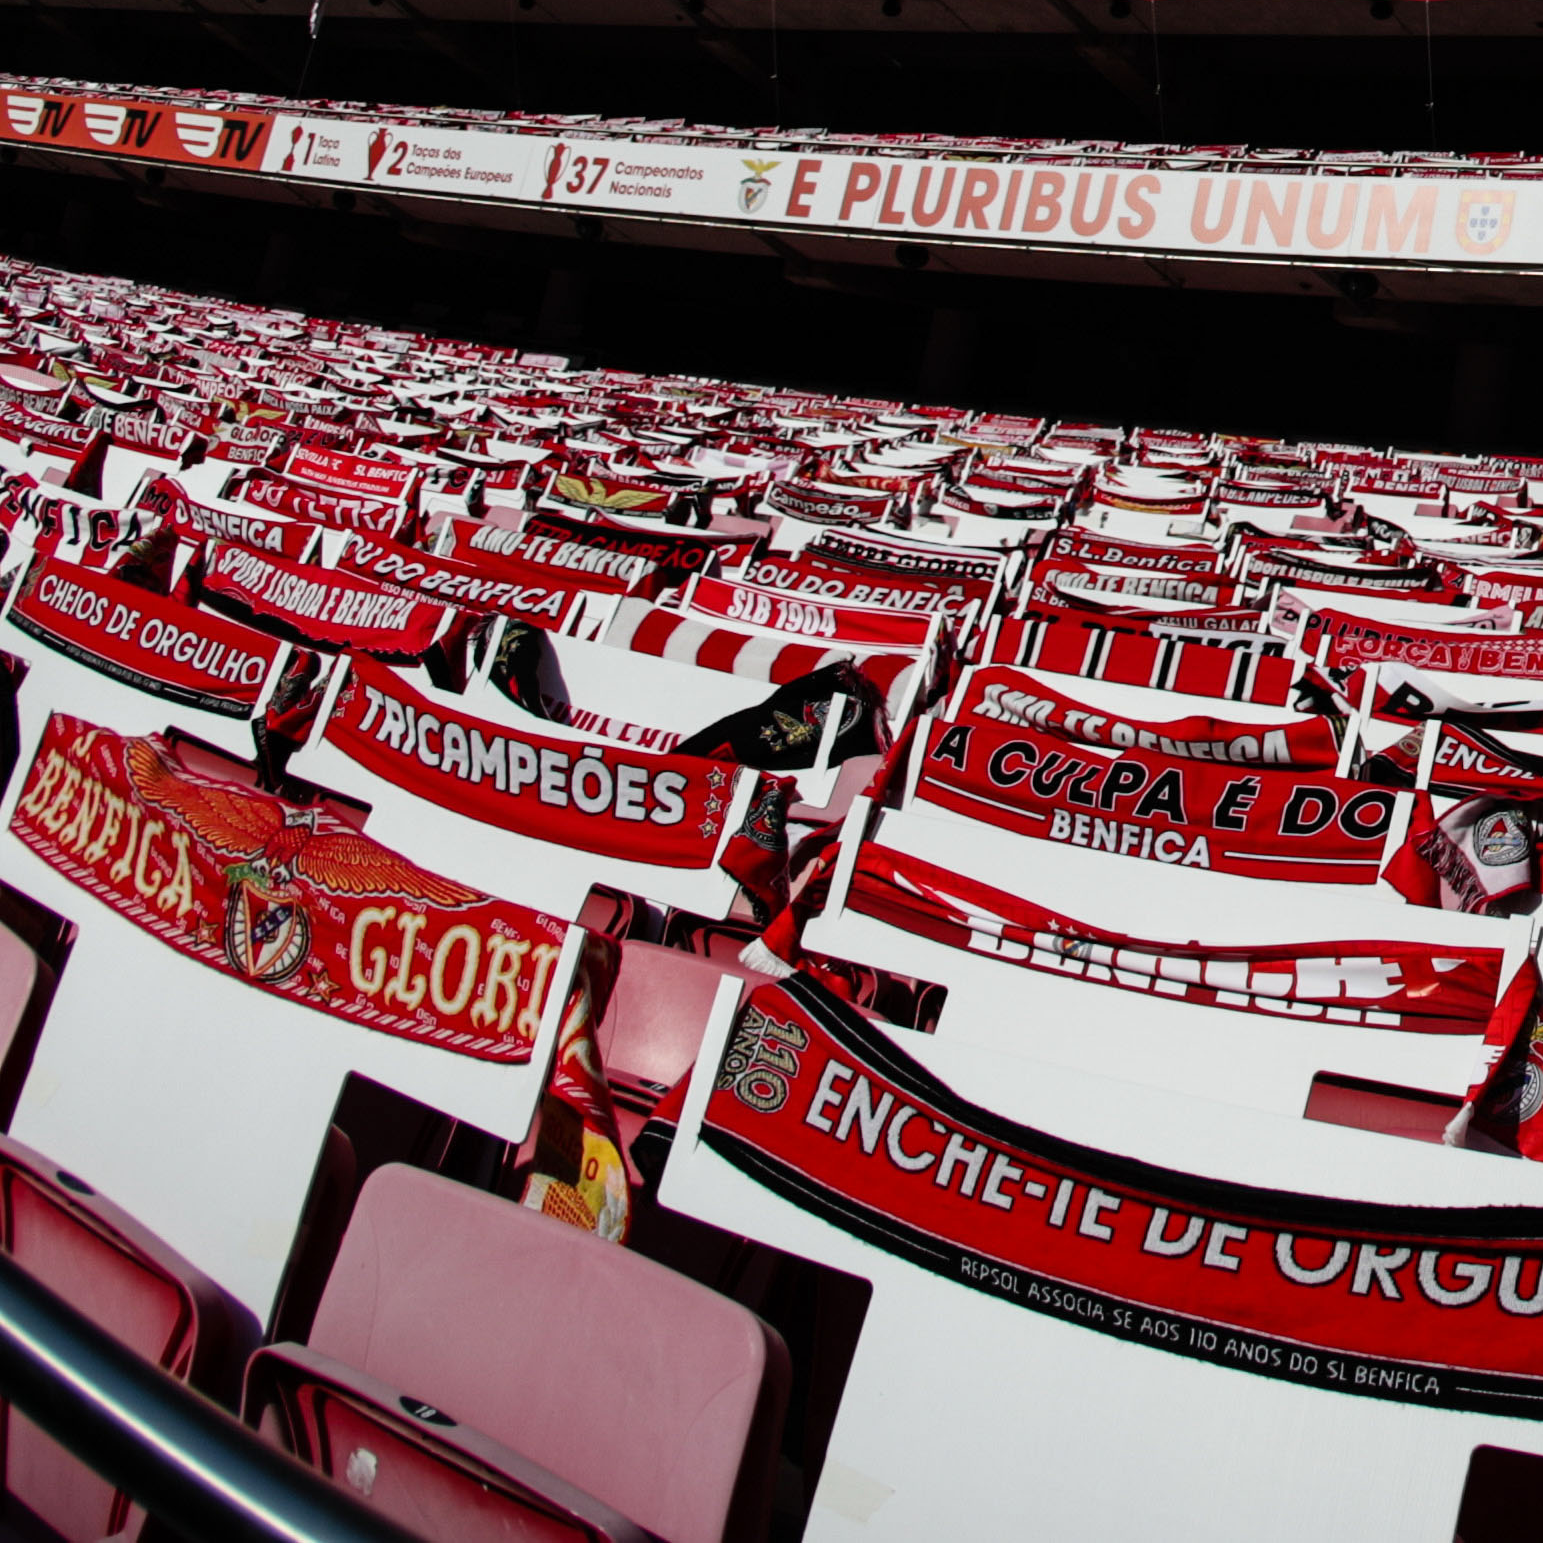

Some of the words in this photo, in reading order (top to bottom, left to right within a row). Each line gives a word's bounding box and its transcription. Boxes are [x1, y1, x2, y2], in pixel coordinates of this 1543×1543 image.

[302, 132, 316, 166] 1
[312, 153, 340, 167] Latina
[319, 135, 340, 150] Taça
[387, 141, 408, 176] 2
[411, 143, 441, 160] Taças
[443, 146, 462, 161] dos
[406, 162, 462, 181] Campeões
[464, 167, 514, 184] Europeus
[565, 156, 611, 195] 37
[609, 180, 672, 199] Nacionais
[614, 161, 705, 181] Campeonatos
[785, 158, 823, 218] E
[837, 160, 1163, 241] PLURIBUS
[1188, 174, 1441, 255] UNUM
[188, 503, 284, 552] BENFICA
[470, 525, 556, 564] AMO-TE
[550, 540, 658, 581] BENFIC
[374, 553, 426, 582] DO
[419, 569, 566, 618] BENFICA
[1102, 547, 1213, 573] Benfica
[218, 547, 274, 595] SPORT
[263, 569, 327, 619] LISBOA
[320, 587, 339, 622] E
[332, 589, 417, 631] BENFICA
[727, 588, 772, 628] SLB
[775, 600, 837, 638] 1904
[798, 574, 845, 600] DO
[39, 575, 105, 627] CHEIOS
[106, 602, 143, 642] DE
[141, 617, 267, 687] ORGULHO
[358, 686, 688, 826] TRICAMPEÕES
[931, 725, 974, 771] A
[988, 740, 1189, 825] CULPA
[1213, 777, 1261, 832] É
[1278, 786, 1398, 840] DO
[24, 748, 194, 918] BENFICA
[1049, 808, 1210, 869] BENFICA
[717, 1006, 765, 1093] ANOS
[735, 1014, 810, 1114] 110
[805, 1058, 1121, 1243] ENCHE-TE
[960, 1255, 1022, 1297] REPSOL
[1140, 1316, 1181, 1343] AOS
[1189, 1326, 1219, 1352] 110
[1224, 1337, 1284, 1369] ANOS
[1289, 1350, 1319, 1376] DO
[1326, 1358, 1349, 1382] SL
[1354, 1364, 1441, 1397] BENFICA
